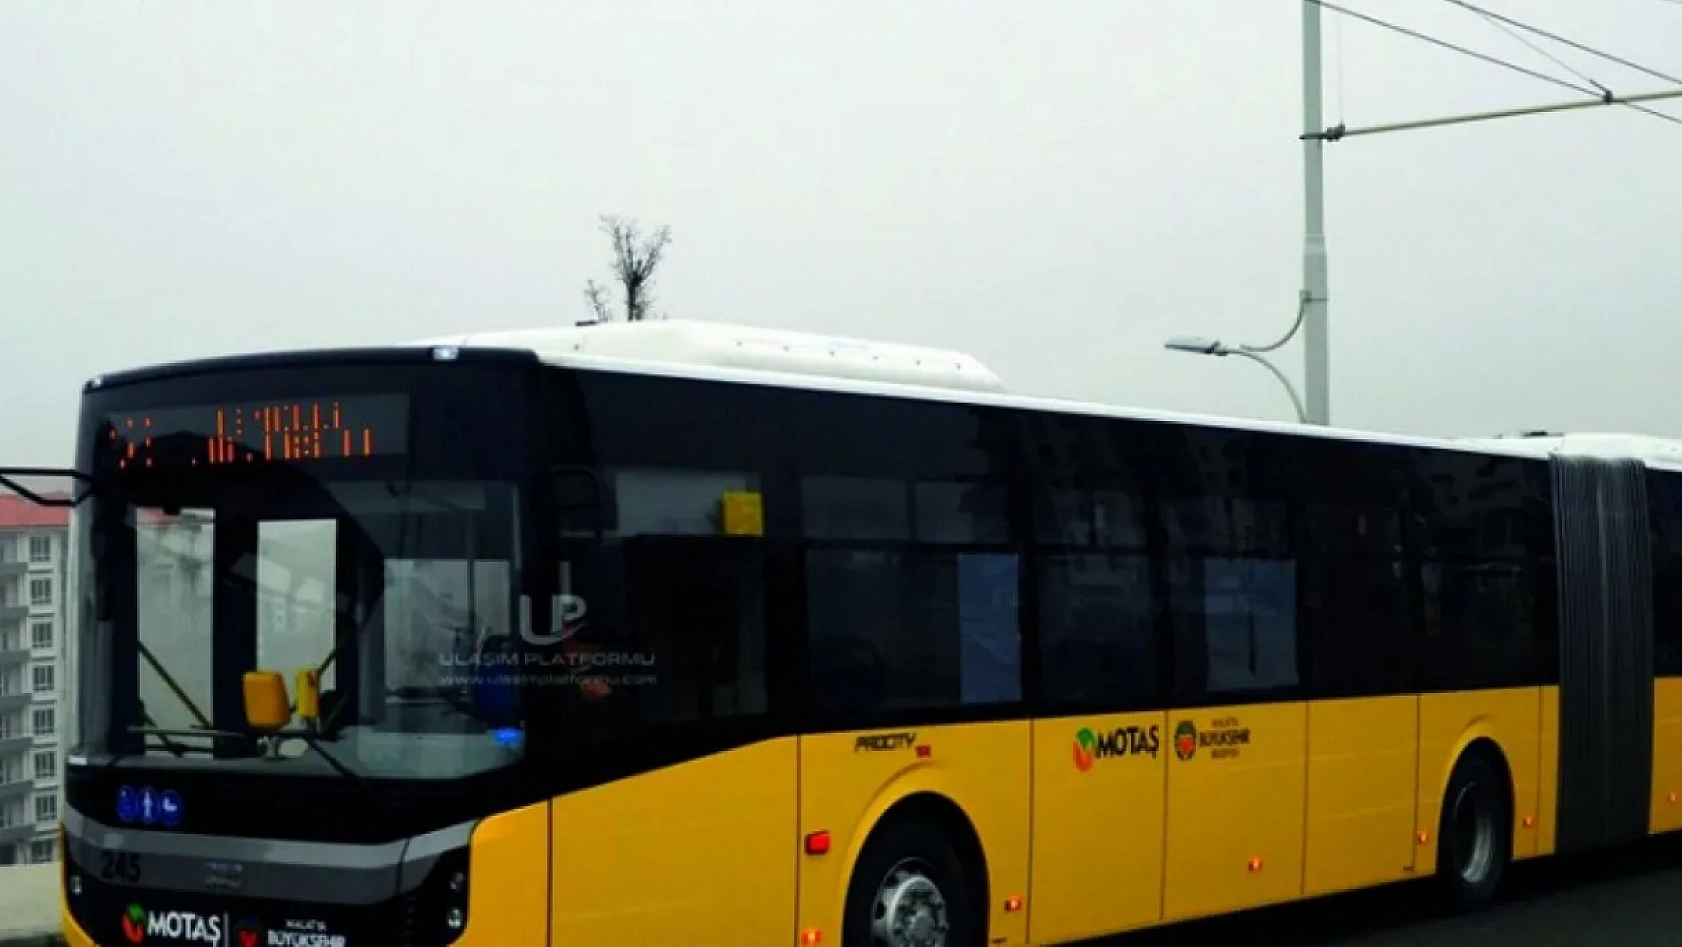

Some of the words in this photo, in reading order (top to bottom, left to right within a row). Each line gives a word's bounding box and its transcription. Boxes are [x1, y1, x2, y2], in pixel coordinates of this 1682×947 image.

[1097, 724, 1160, 759] MOTAŞ
[102, 848, 141, 884] 245
[147, 909, 222, 947] MOTAŞ
